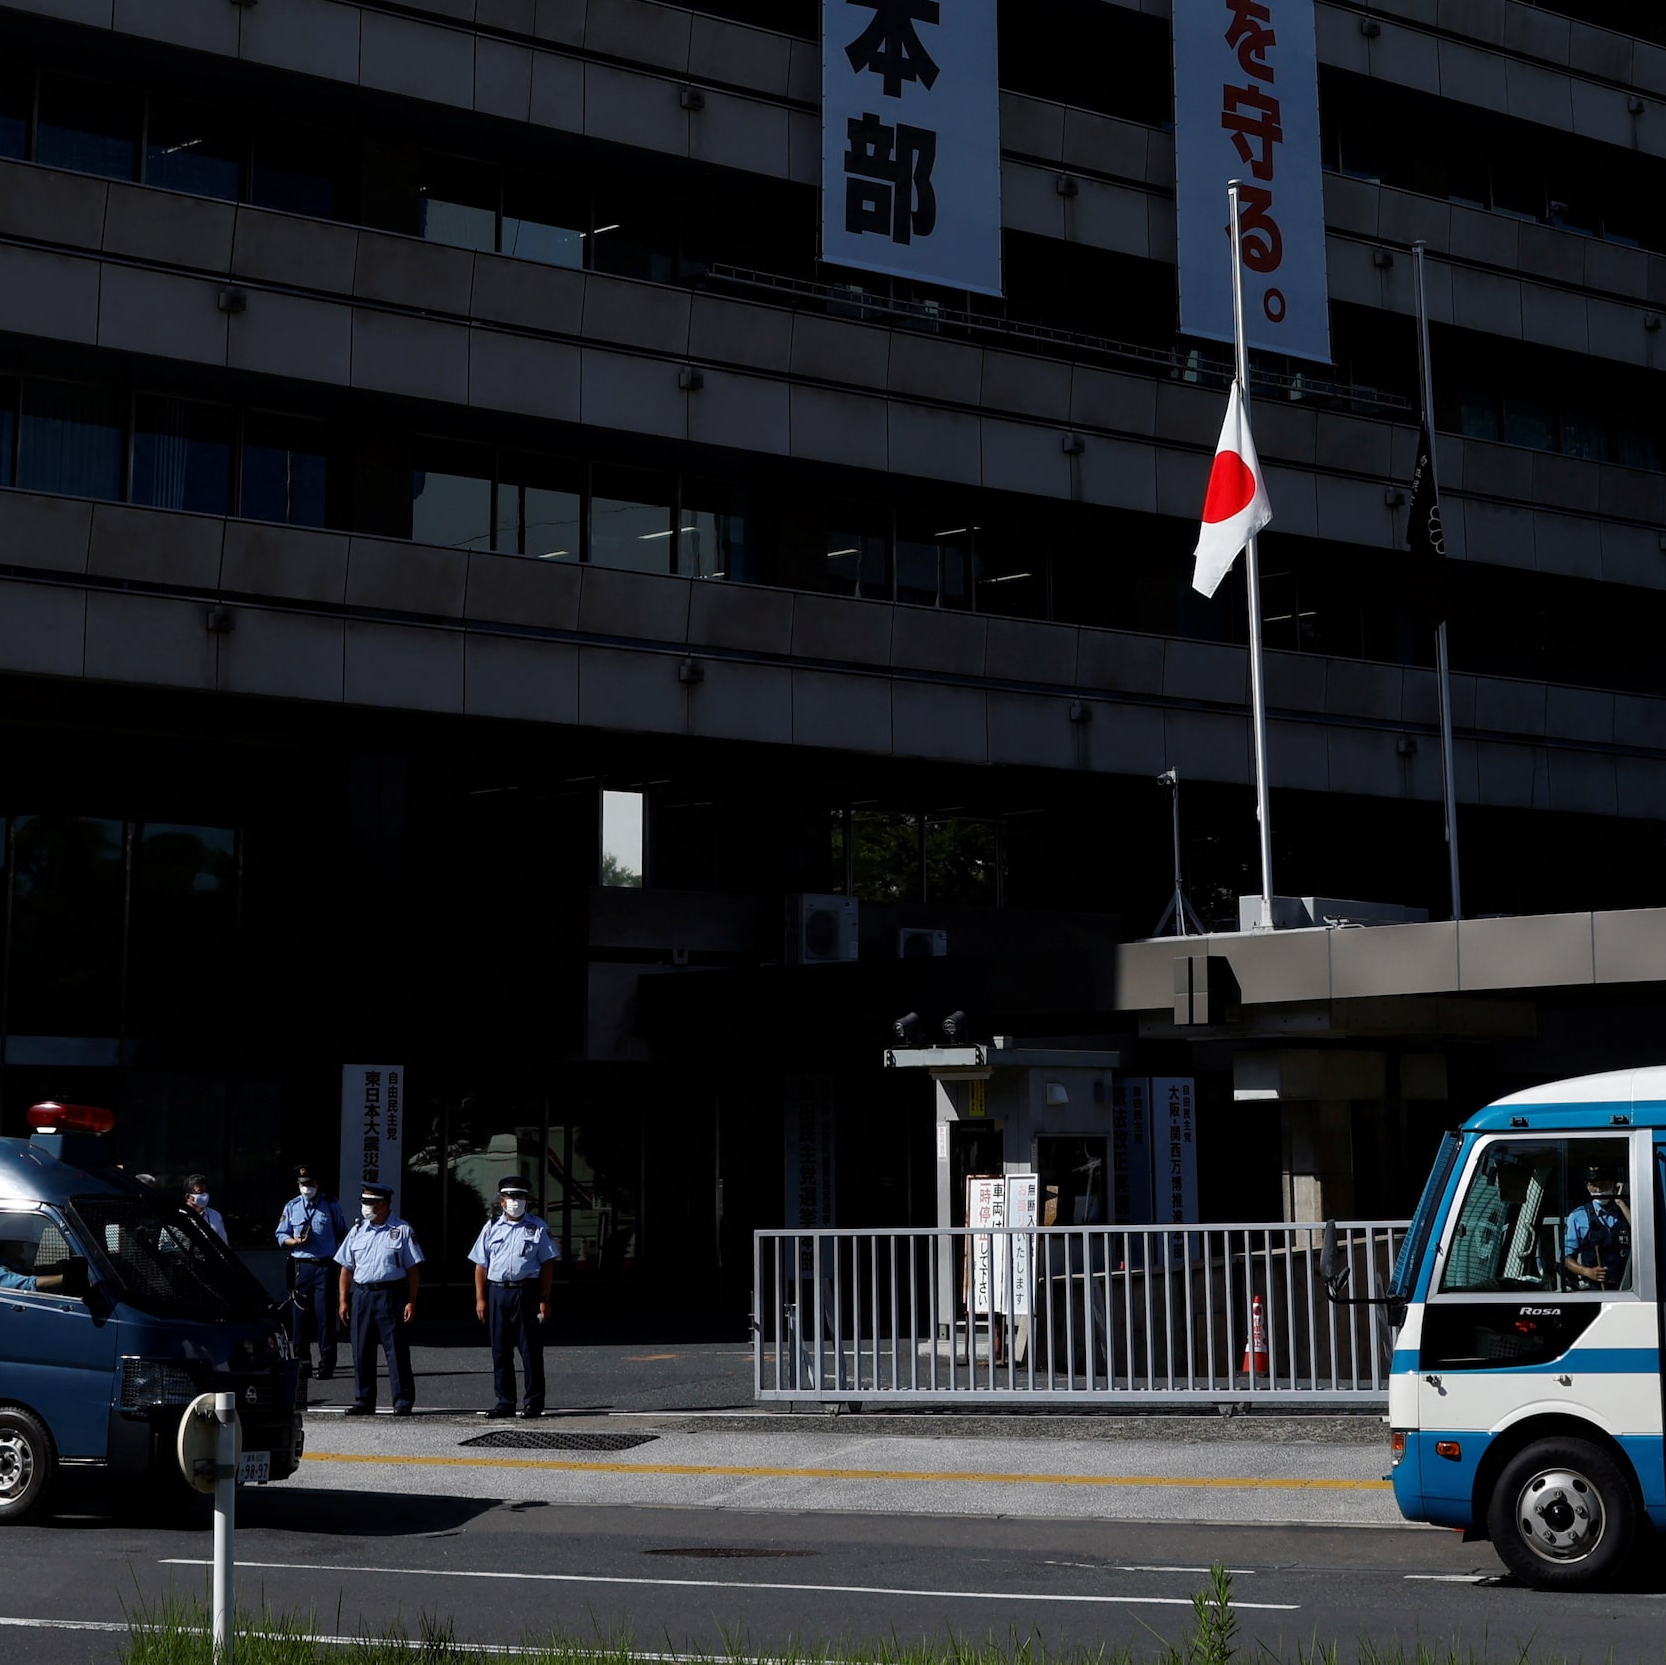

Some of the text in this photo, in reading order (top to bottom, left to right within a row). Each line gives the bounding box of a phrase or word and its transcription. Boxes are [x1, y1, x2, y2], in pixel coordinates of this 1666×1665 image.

[386, 1071, 398, 1141] 自由民主党
[1182, 1085, 1192, 1143] 自由民主党
